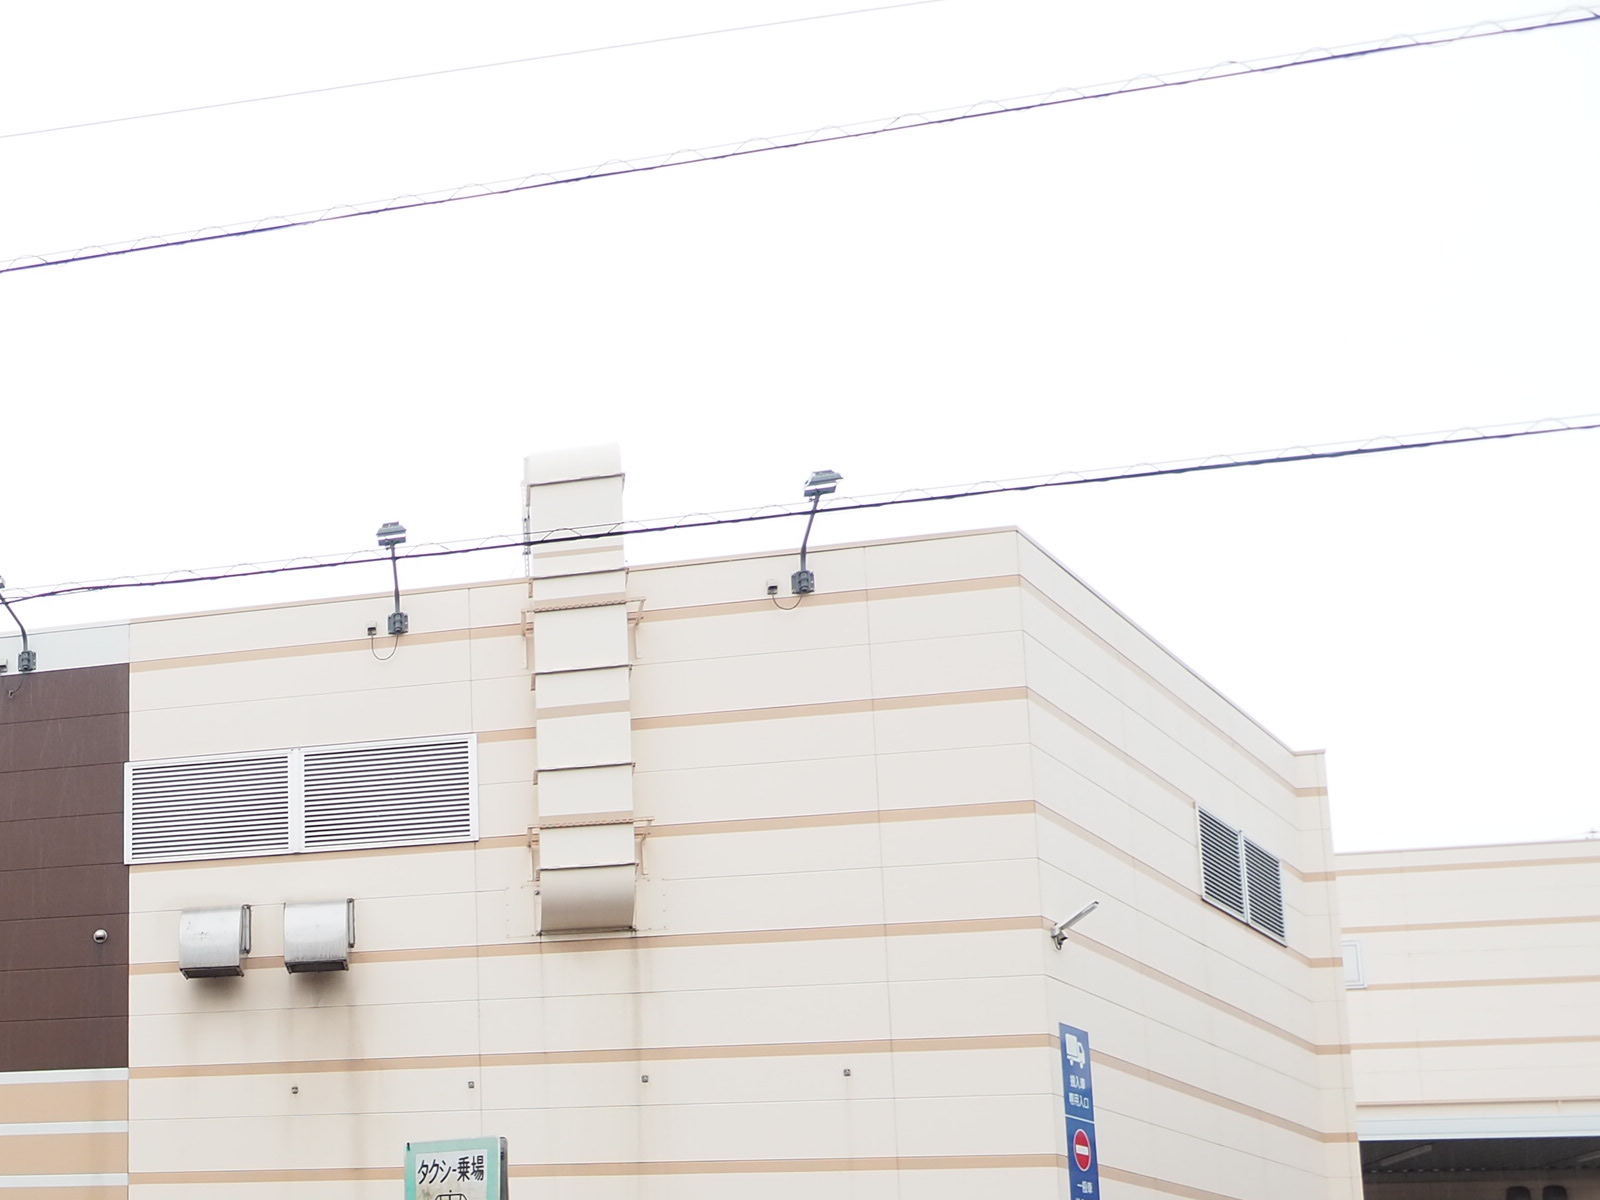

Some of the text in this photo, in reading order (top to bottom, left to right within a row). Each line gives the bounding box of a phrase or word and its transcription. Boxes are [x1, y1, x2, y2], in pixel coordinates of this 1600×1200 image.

[417, 1154, 485, 1185] タクシー乗場
